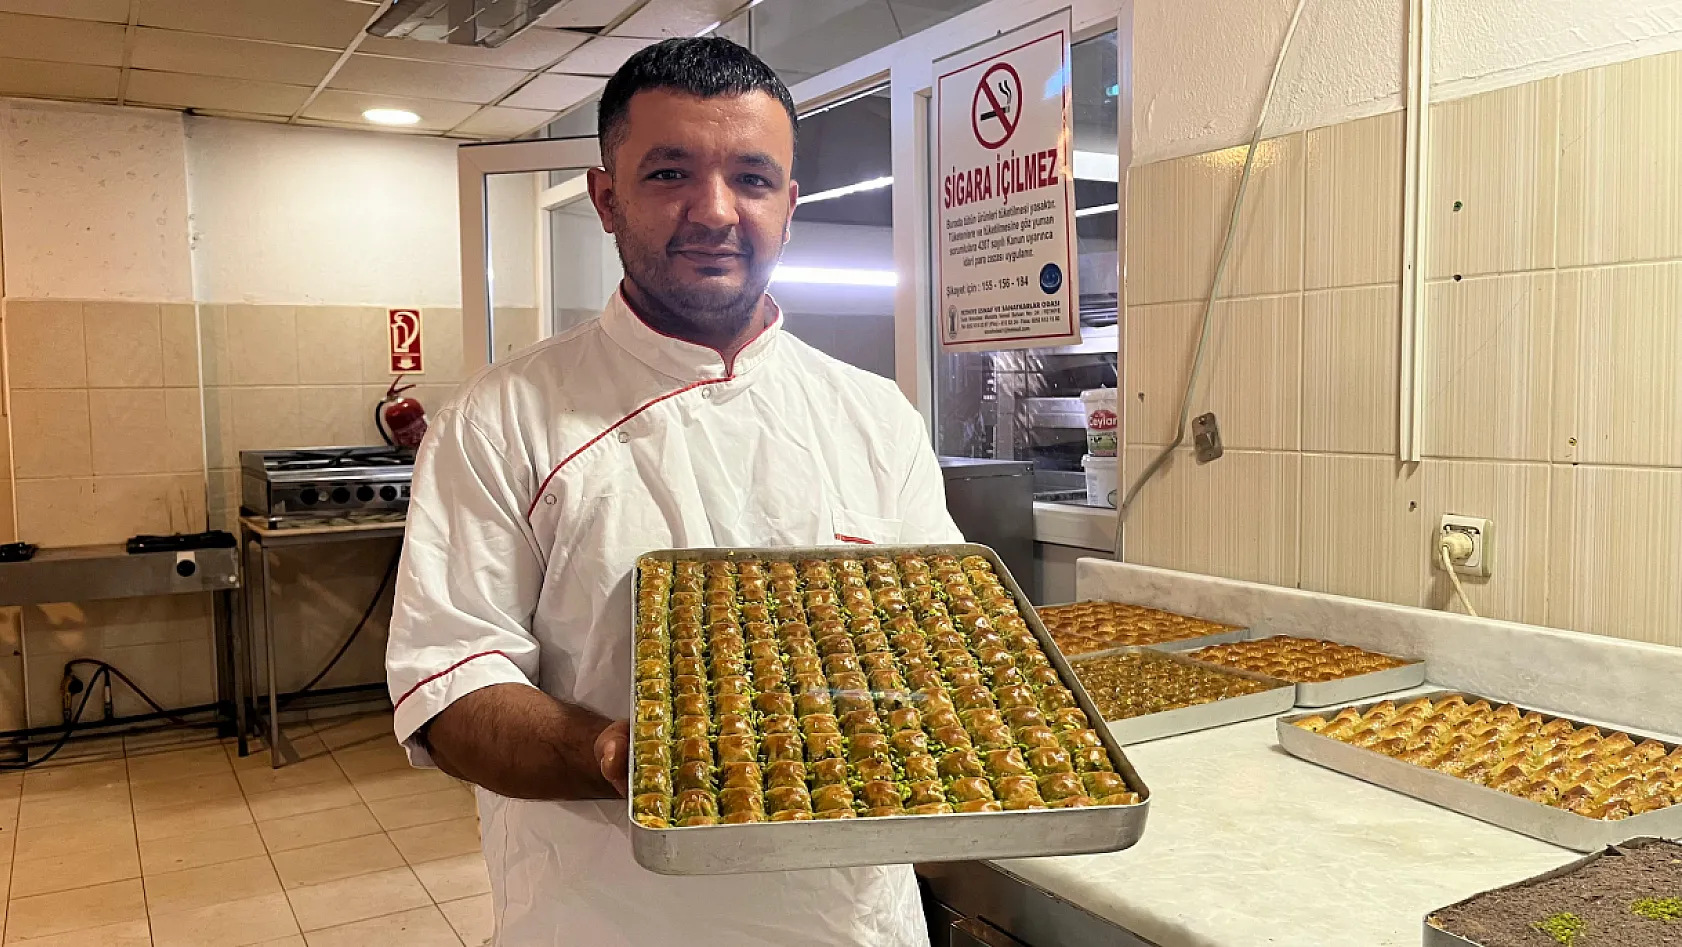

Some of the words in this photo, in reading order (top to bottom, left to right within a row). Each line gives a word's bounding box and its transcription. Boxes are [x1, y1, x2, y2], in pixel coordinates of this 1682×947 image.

[944, 166, 993, 209] SİGARA
[996, 149, 1059, 206] İÇİLMEZ
[983, 221, 1019, 235] tüketilmesine
[1020, 218, 1031, 231] göz
[1032, 215, 1055, 230] yuman
[1006, 234, 1025, 246] Kanun
[1026, 230, 1054, 245] uyarınca
[975, 254, 986, 268] para
[946, 284, 965, 299] Şikayet
[966, 282, 977, 296] için
[981, 279, 993, 291] 155
[998, 277, 1010, 289] 156
